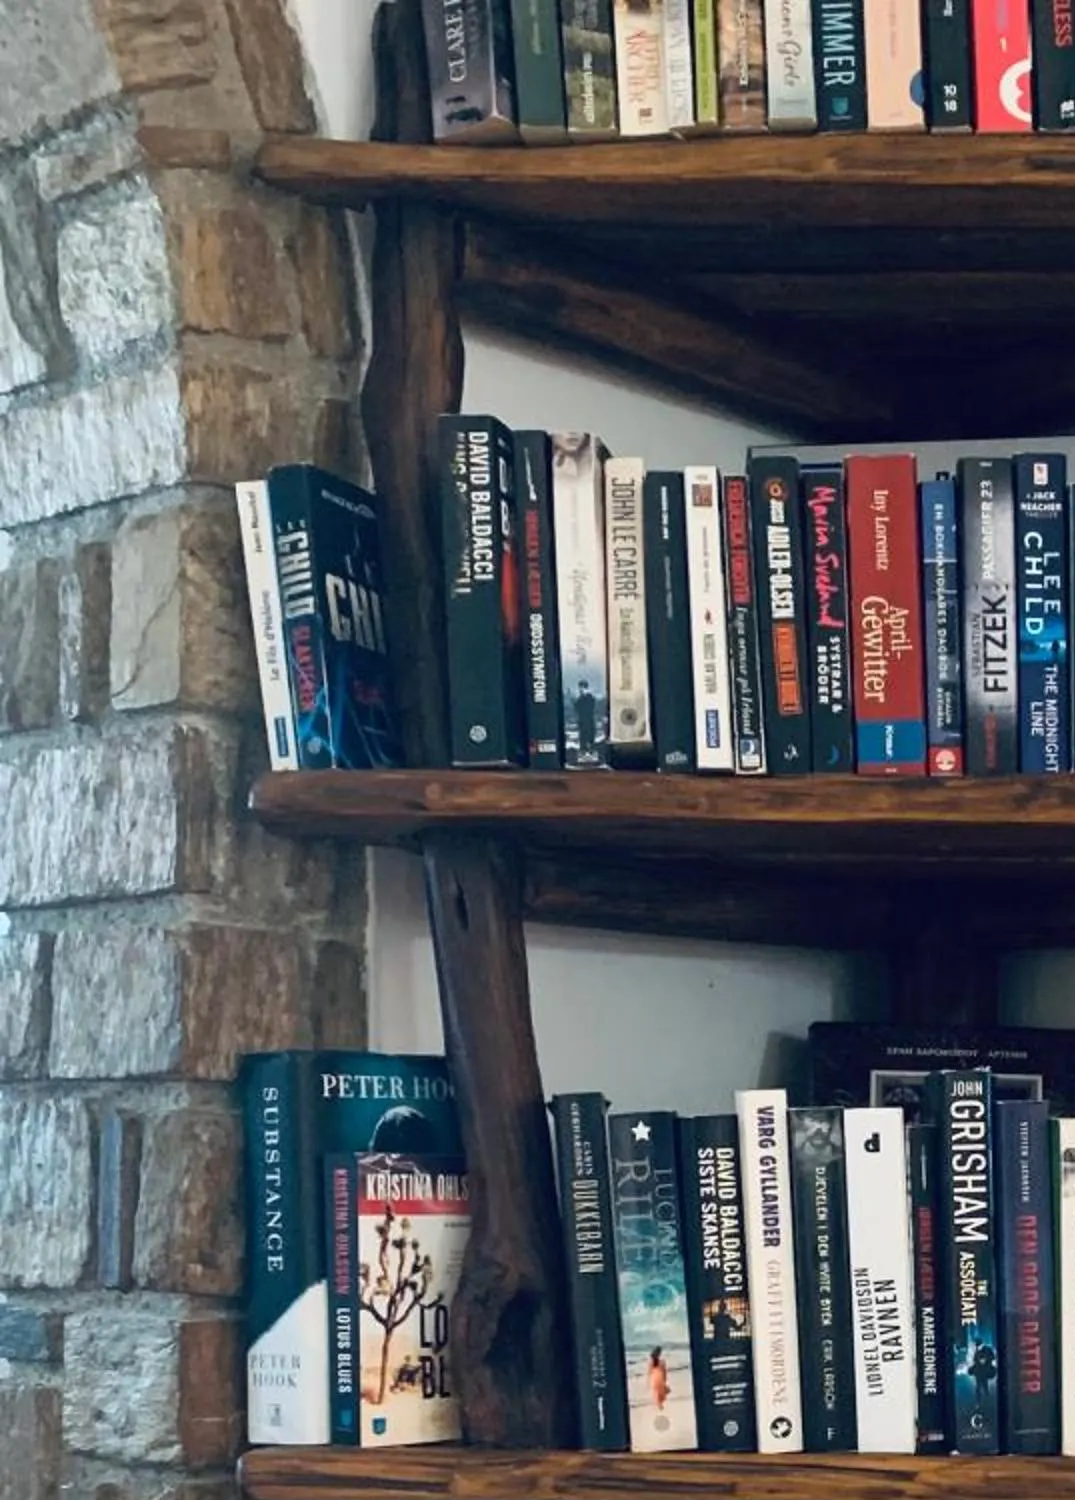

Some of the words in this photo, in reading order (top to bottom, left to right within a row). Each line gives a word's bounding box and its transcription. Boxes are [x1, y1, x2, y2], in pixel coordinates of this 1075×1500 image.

[468, 430, 489, 488] DAVID
[980, 480, 993, 497] 23
[611, 477, 635, 521] JOHN
[471, 490, 495, 581] BALDACCI
[613, 525, 636, 545] LE
[278, 530, 316, 618] CHILD
[613, 547, 640, 601] CARRÉ
[767, 525, 795, 619] ADLER-OLSEN
[1023, 531, 1044, 635] CHILD
[1042, 551, 1061, 613] LEE
[860, 595, 889, 703] Gewitter
[983, 595, 1009, 694] FITZEK
[1043, 664, 1059, 695] THE
[1030, 702, 1044, 737] LINE
[1044, 699, 1060, 773] MIDNIGHT
[320, 1073, 405, 1100] PETER
[950, 1080, 984, 1098] JOHN
[757, 1105, 777, 1149] VARG
[262, 1086, 283, 1273] SUBSTANCE
[365, 1169, 434, 1202] KRISTINA
[697, 1148, 715, 1198] SISTE
[714, 1147, 737, 1201] DAVID
[759, 1152, 782, 1249] GYLLANDER
[950, 1099, 990, 1244] GRISHAM
[573, 1179, 605, 1274] DUKKEBARN
[701, 1202, 721, 1270] SKANSE
[719, 1203, 744, 1292] BALDACCI
[1016, 1214, 1038, 1257] DEN
[853, 1266, 877, 1331] DAVIDSON
[954, 1250, 978, 1327] ASSOCIATE
[978, 1279, 988, 1298] THE
[336, 1307, 351, 1348] LOTUS
[873, 1278, 905, 1364] RAVNEN
[921, 1306, 937, 1395] KAMELEONENE
[249, 1352, 301, 1371] PETER
[252, 1372, 297, 1389] HOOK
[338, 1352, 353, 1394] BLUES
[863, 1334, 884, 1397] LIONEL
[1018, 1320, 1041, 1394] DATTER
